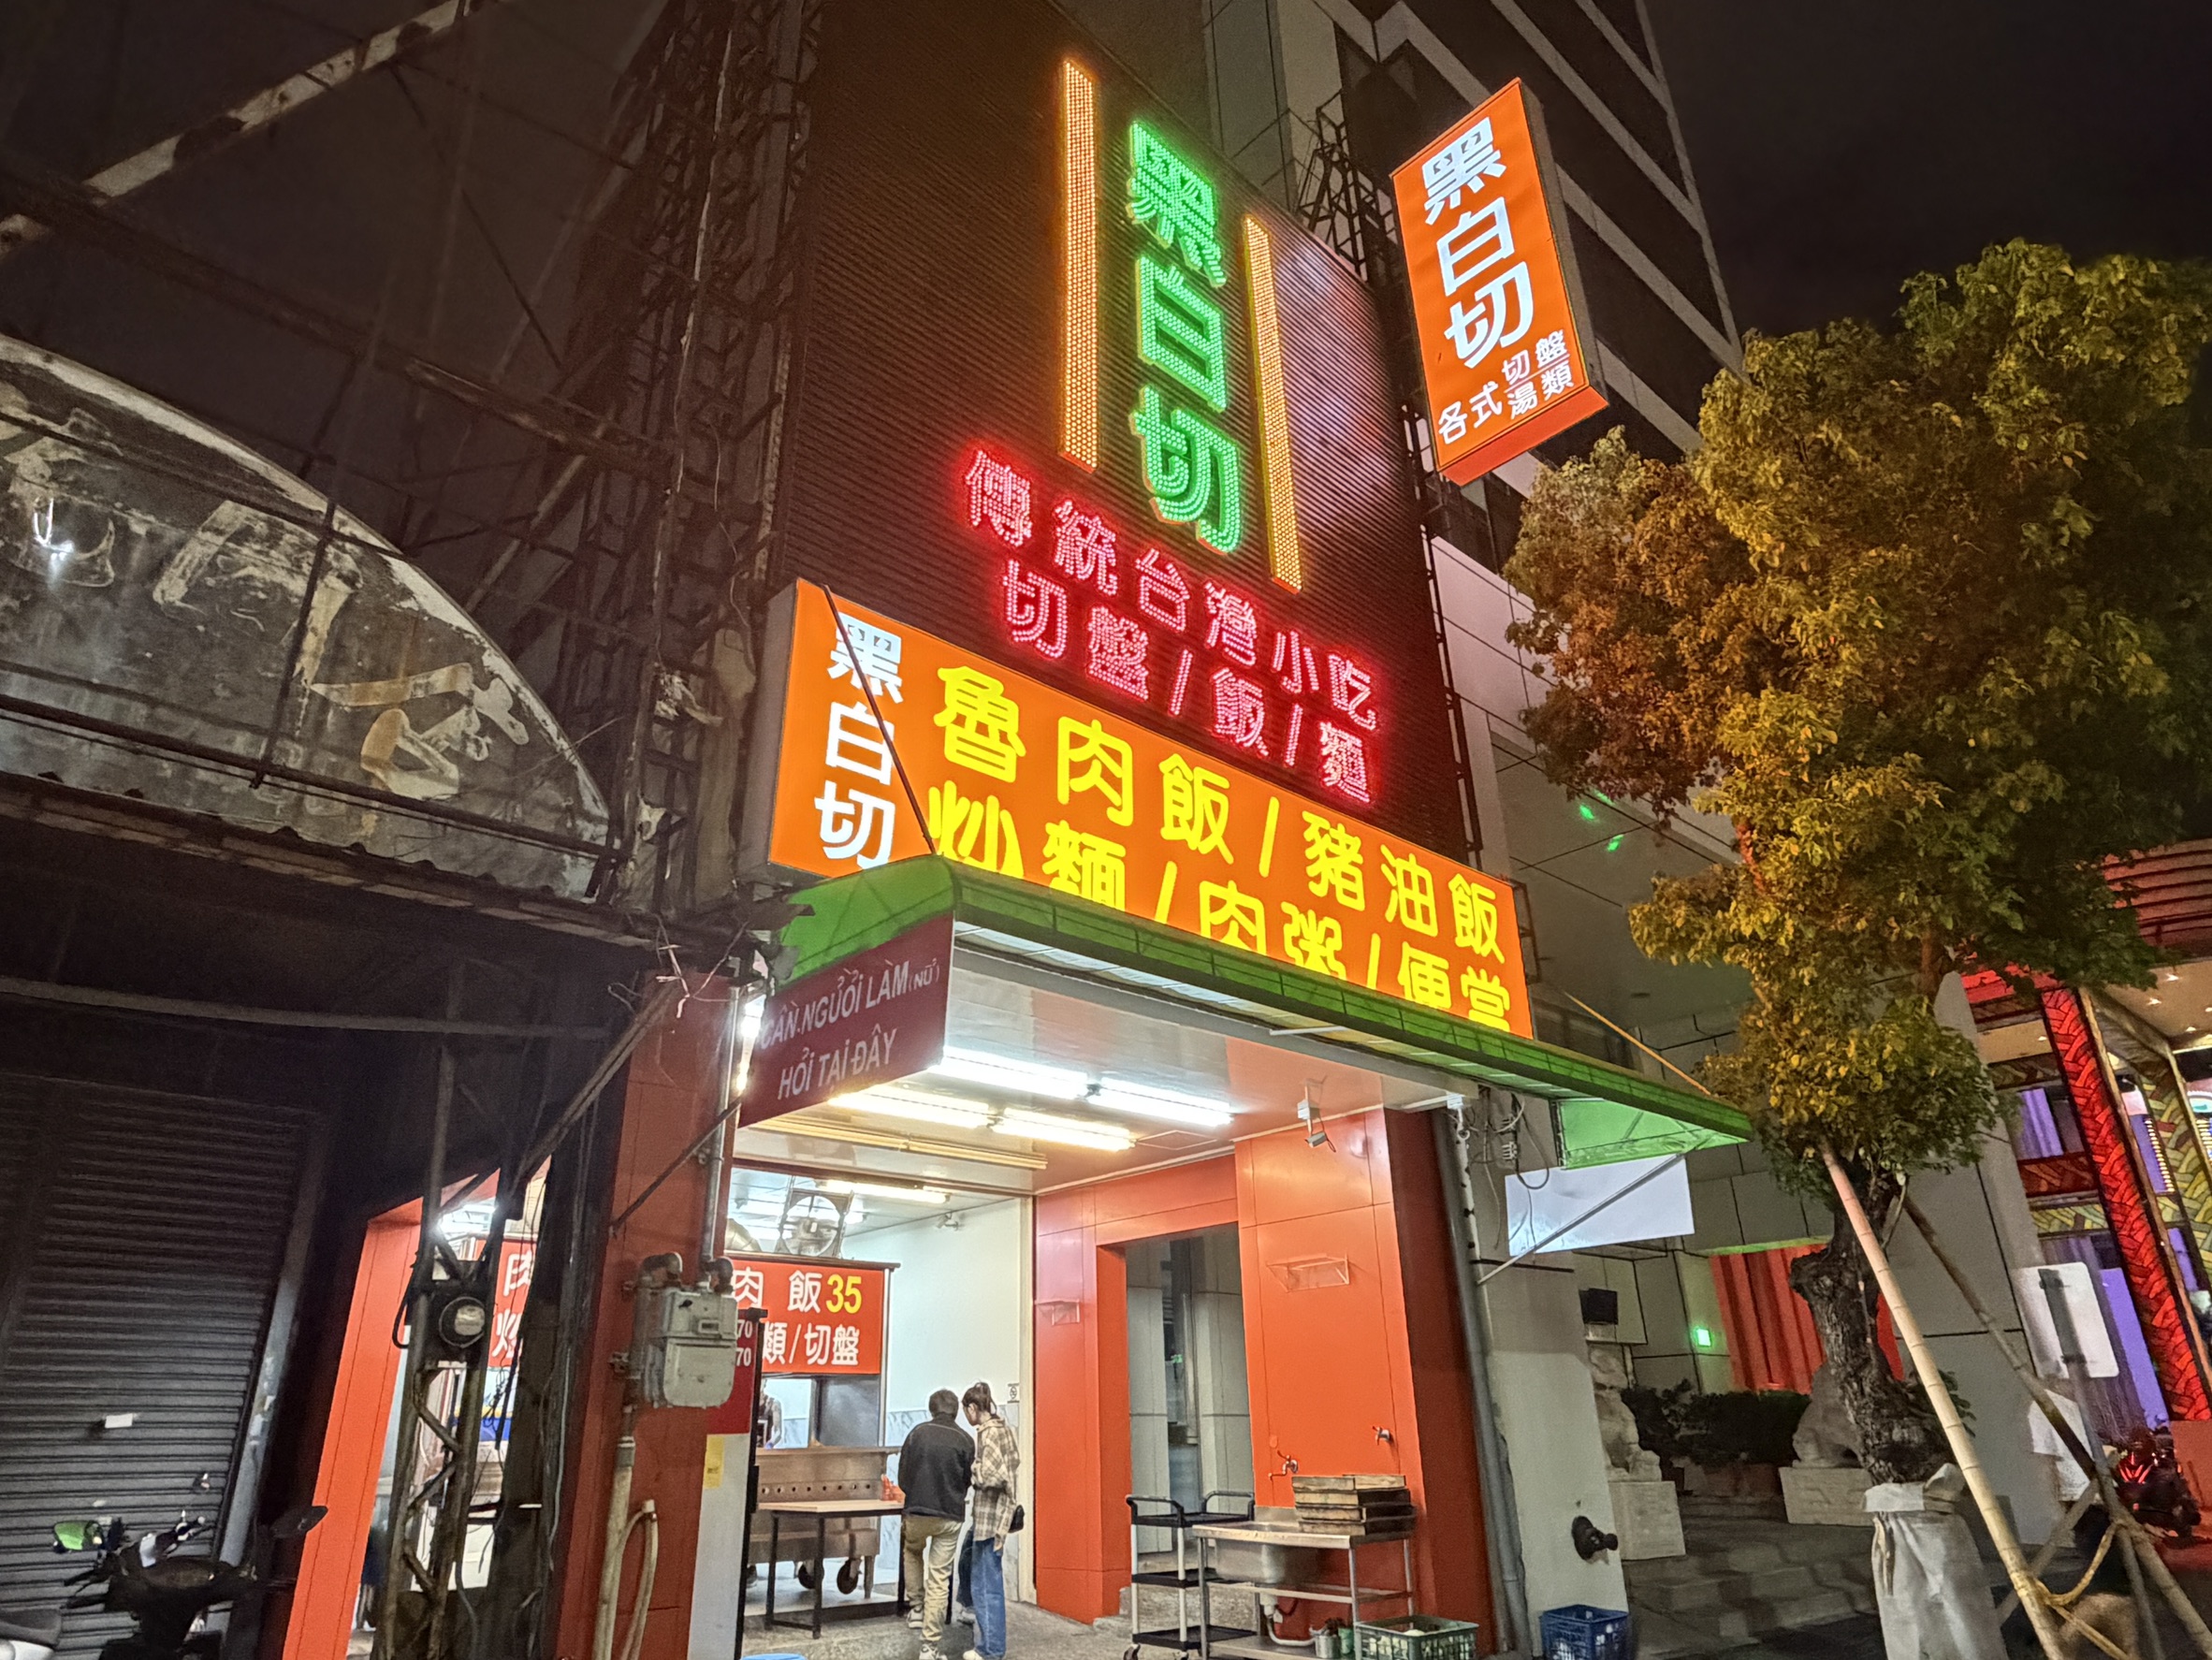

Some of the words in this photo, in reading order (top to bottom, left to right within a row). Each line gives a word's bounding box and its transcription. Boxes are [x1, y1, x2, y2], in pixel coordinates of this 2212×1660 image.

[1128, 120, 1242, 554] 黑白切
[1423, 116, 1535, 369] 黑白切
[1437, 379, 1504, 445] 各式
[1506, 361, 1575, 421] 湯類
[965, 450, 1376, 732] 傳統台灣小吃
[813, 610, 904, 869] 黑白切
[933, 665, 1506, 964] 魯肉飯/豬油飯
[825, 1274, 863, 1314] 35
